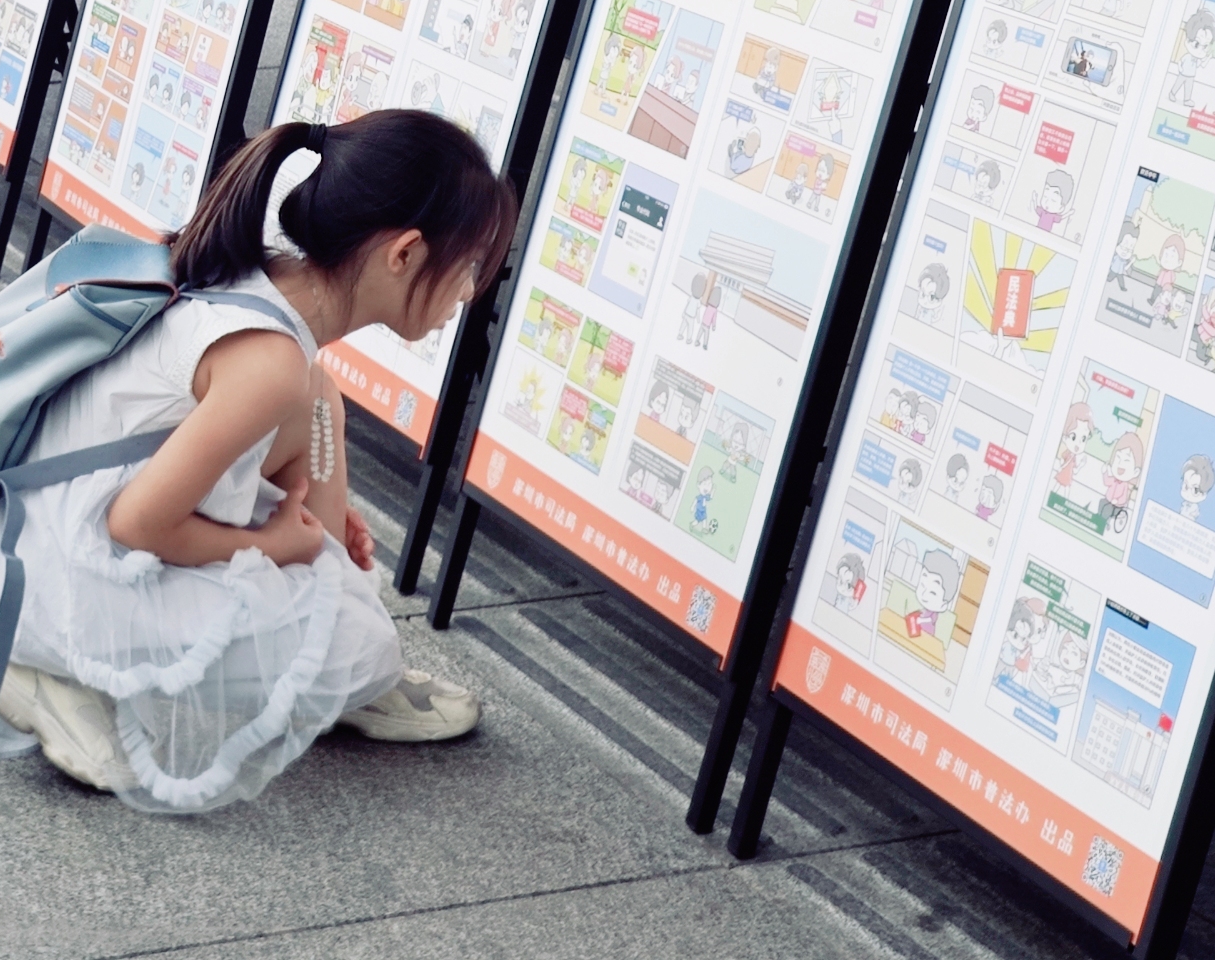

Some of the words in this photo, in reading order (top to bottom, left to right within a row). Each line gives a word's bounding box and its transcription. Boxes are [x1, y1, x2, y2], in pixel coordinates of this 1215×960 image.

[1002, 275, 1020, 328] 民法典
[512, 476, 577, 533] 深圳市司法局
[656, 575, 681, 604] 出品
[840, 682, 929, 756] 深圳市司法局
[935, 746, 1031, 826] 深圳市普法办
[1040, 818, 1076, 857] 出品
